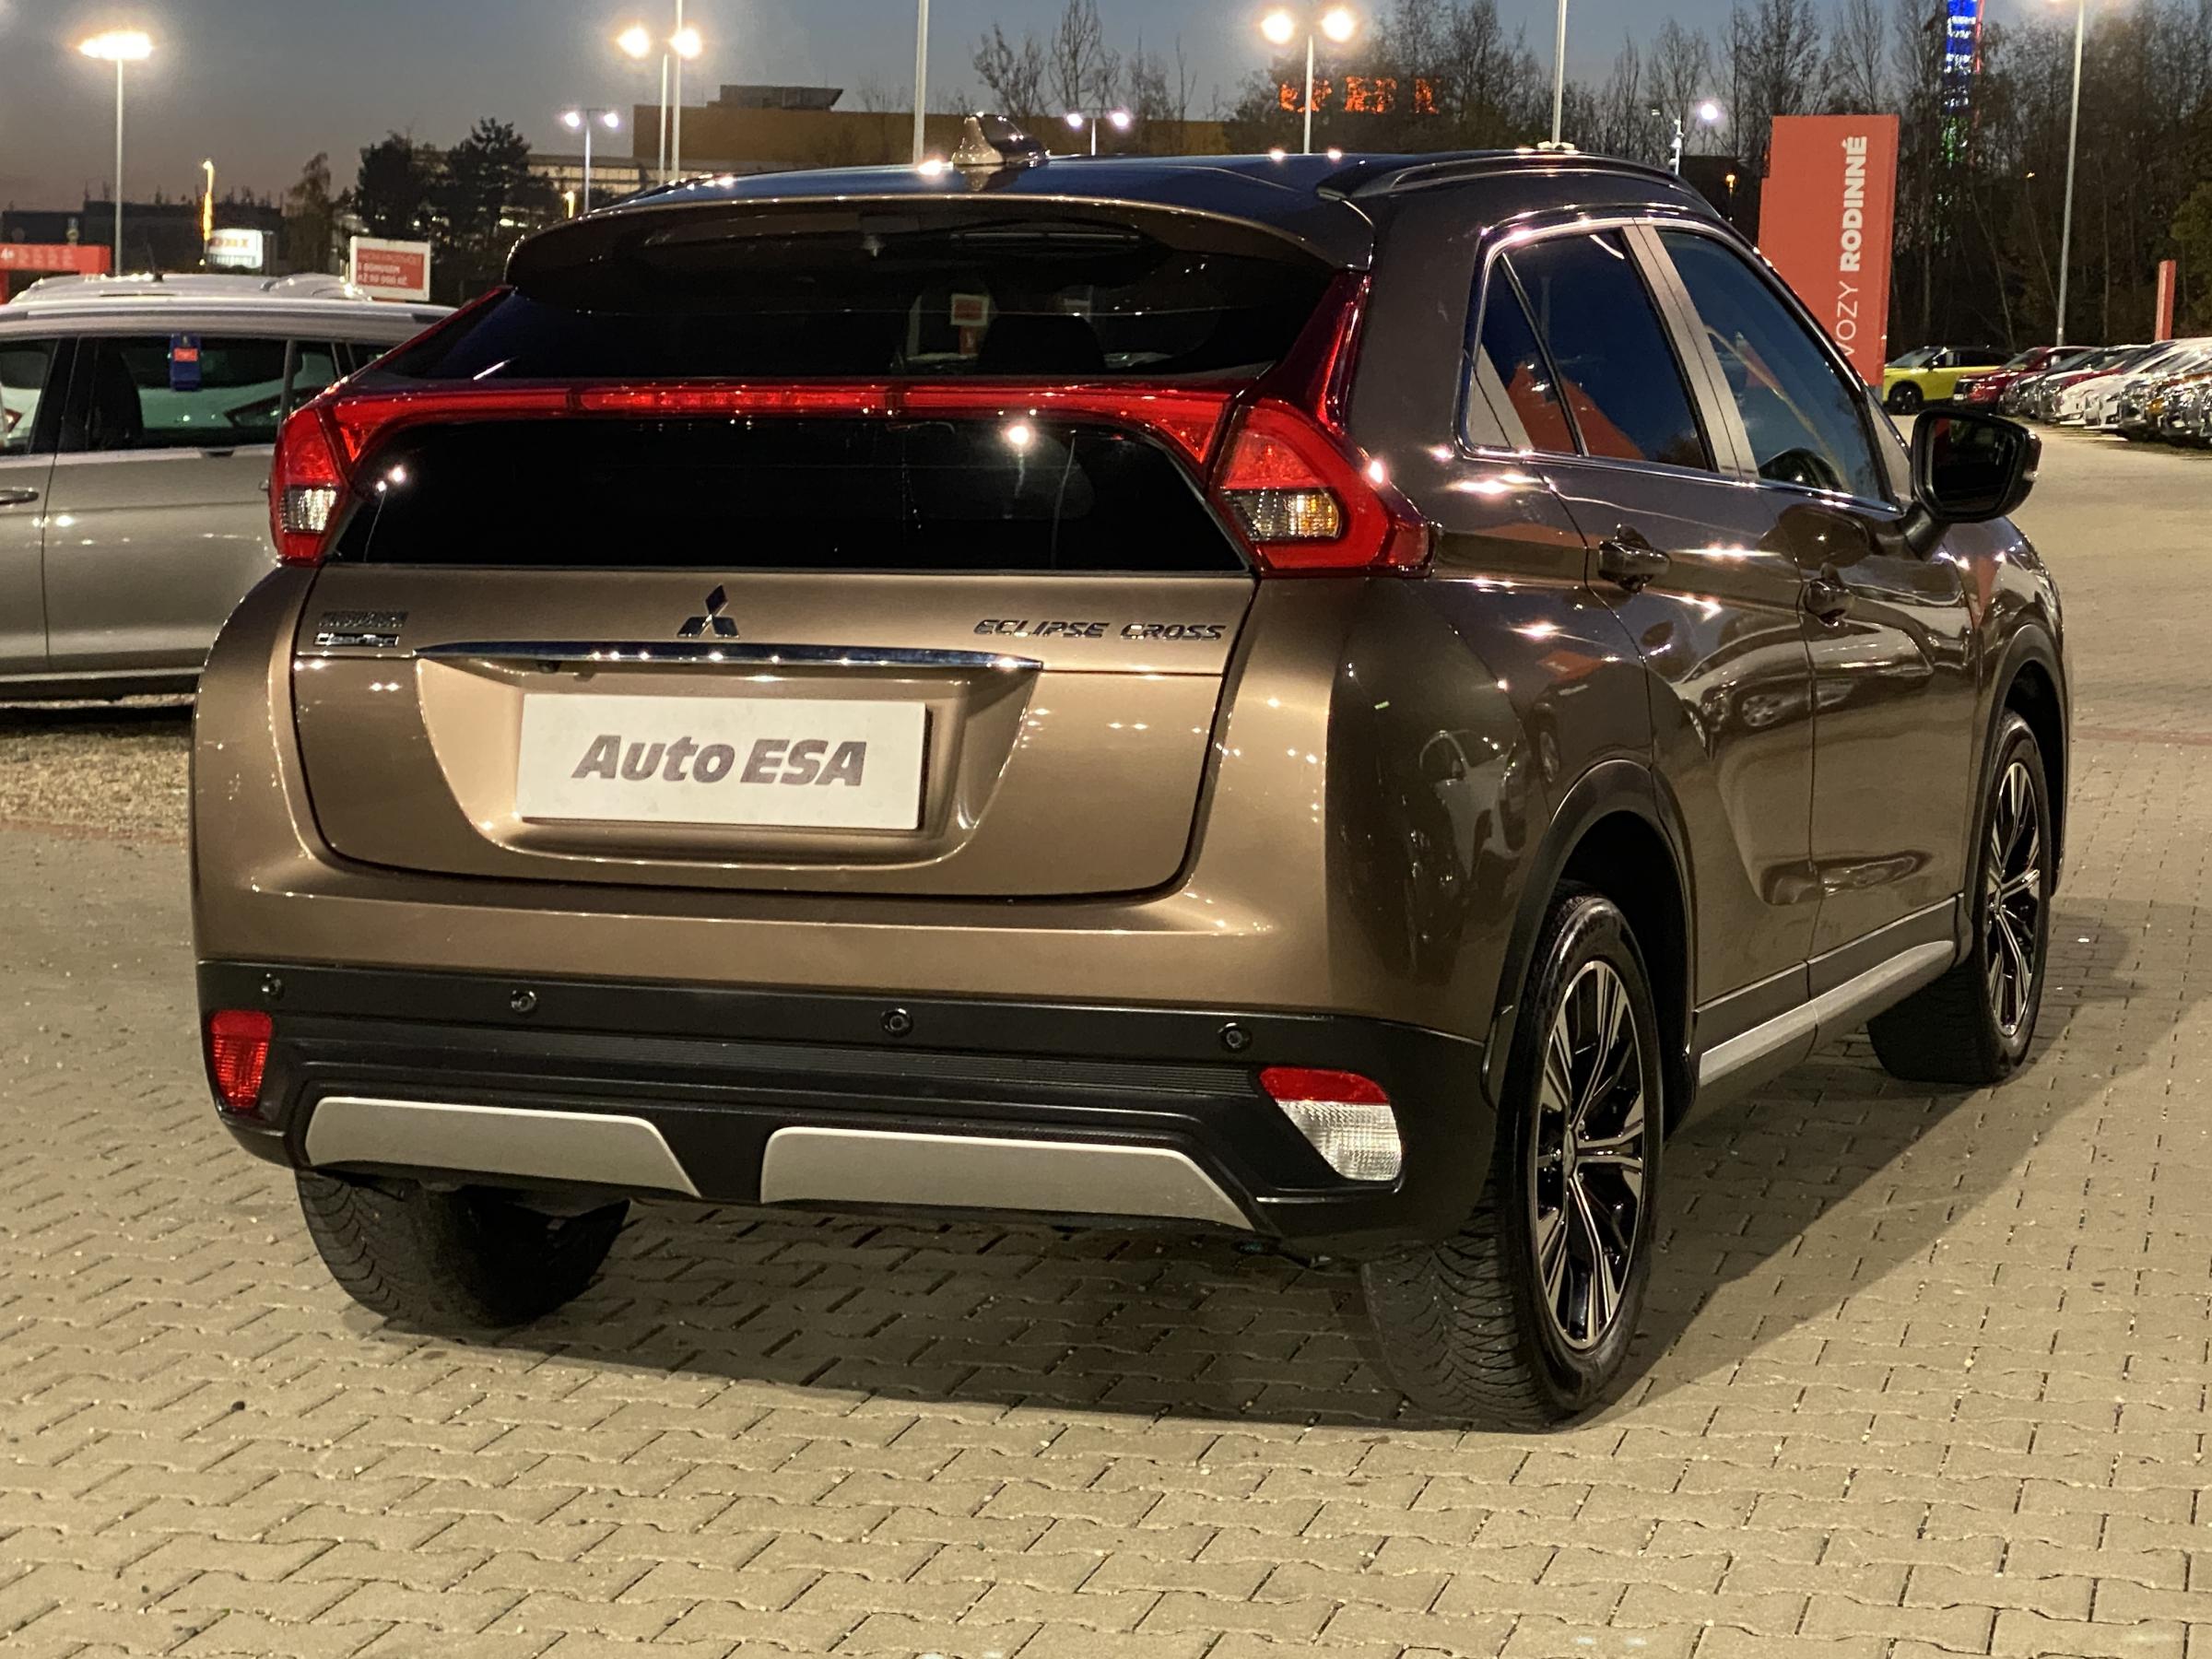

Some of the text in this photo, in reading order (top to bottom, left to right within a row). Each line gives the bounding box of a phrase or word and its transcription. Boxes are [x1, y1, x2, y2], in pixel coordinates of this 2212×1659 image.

[1835, 136, 1868, 357] VOZY RODINNÉ
[973, 618, 1227, 641] ECLIPSE CROSS
[739, 738, 867, 786] ESA
